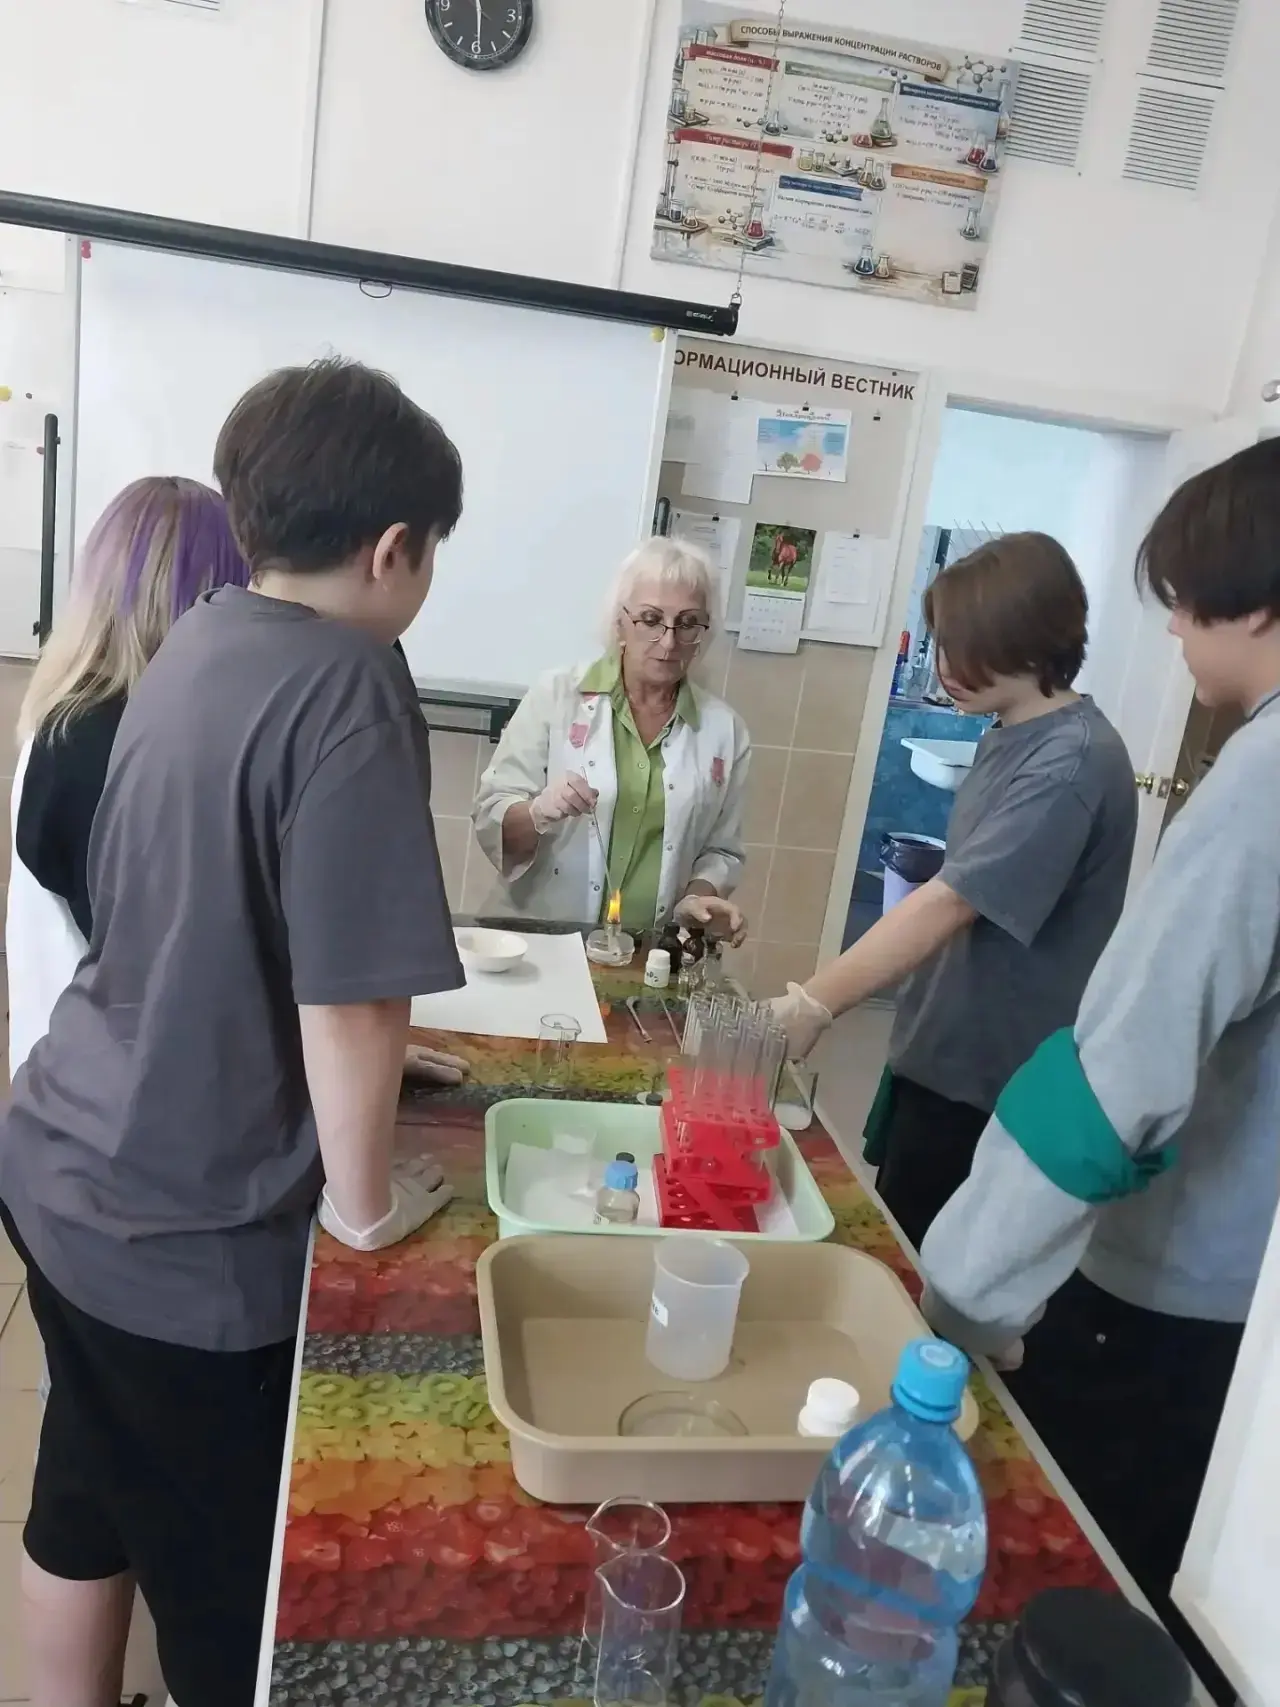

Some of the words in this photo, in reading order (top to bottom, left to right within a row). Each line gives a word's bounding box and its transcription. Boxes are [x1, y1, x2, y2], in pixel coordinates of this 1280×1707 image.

[440, 0, 450, 11] 9
[506, 9, 516, 23] 3
[471, 40, 481, 54] 6
[740, 26, 780, 37] СПОСОБЫ
[782, 29, 833, 43] ВЫРАЖЕНИЯ
[834, 37, 897, 57] КОНЦЕНТРАЦИИ
[898, 51, 942, 71] РАСТВОРОВ
[831, 373, 915, 400] ВЕСТНИК
